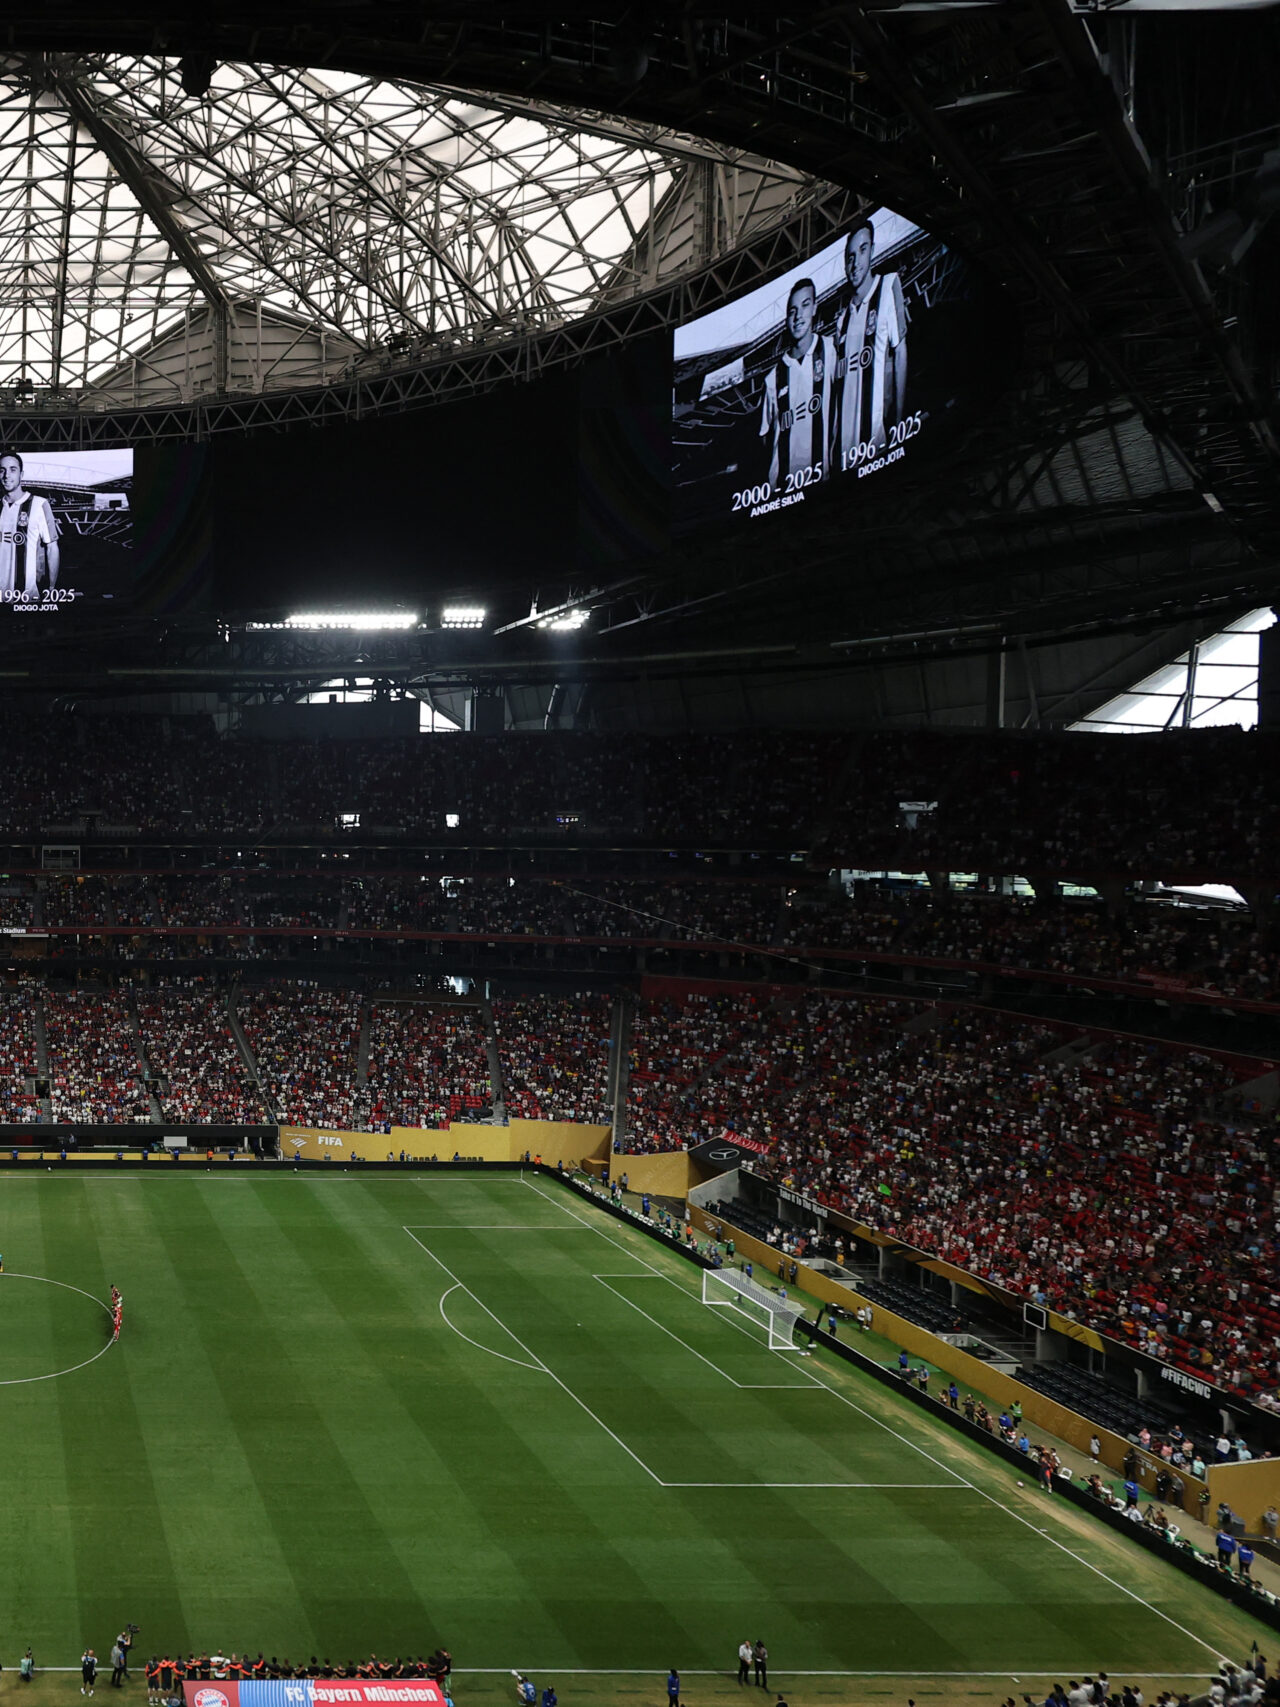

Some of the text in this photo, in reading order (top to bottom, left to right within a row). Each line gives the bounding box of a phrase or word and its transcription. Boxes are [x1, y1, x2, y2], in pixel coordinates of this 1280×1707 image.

[841, 437, 876, 472] 1996
[888, 410, 921, 447] 2025
[858, 446, 905, 478] DIOGO JOTA
[731, 482, 771, 511] 2000
[785, 462, 823, 494] 2025
[750, 491, 804, 517] ANDRÉ SILVA
[13, 604, 58, 612] DIOGO JOTA
[42, 588, 75, 602] 2025
[318, 1136, 343, 1146] FIFA
[1161, 1367, 1211, 1399] #FIFACWC
[285, 1687, 438, 1703] FC Bayern München
